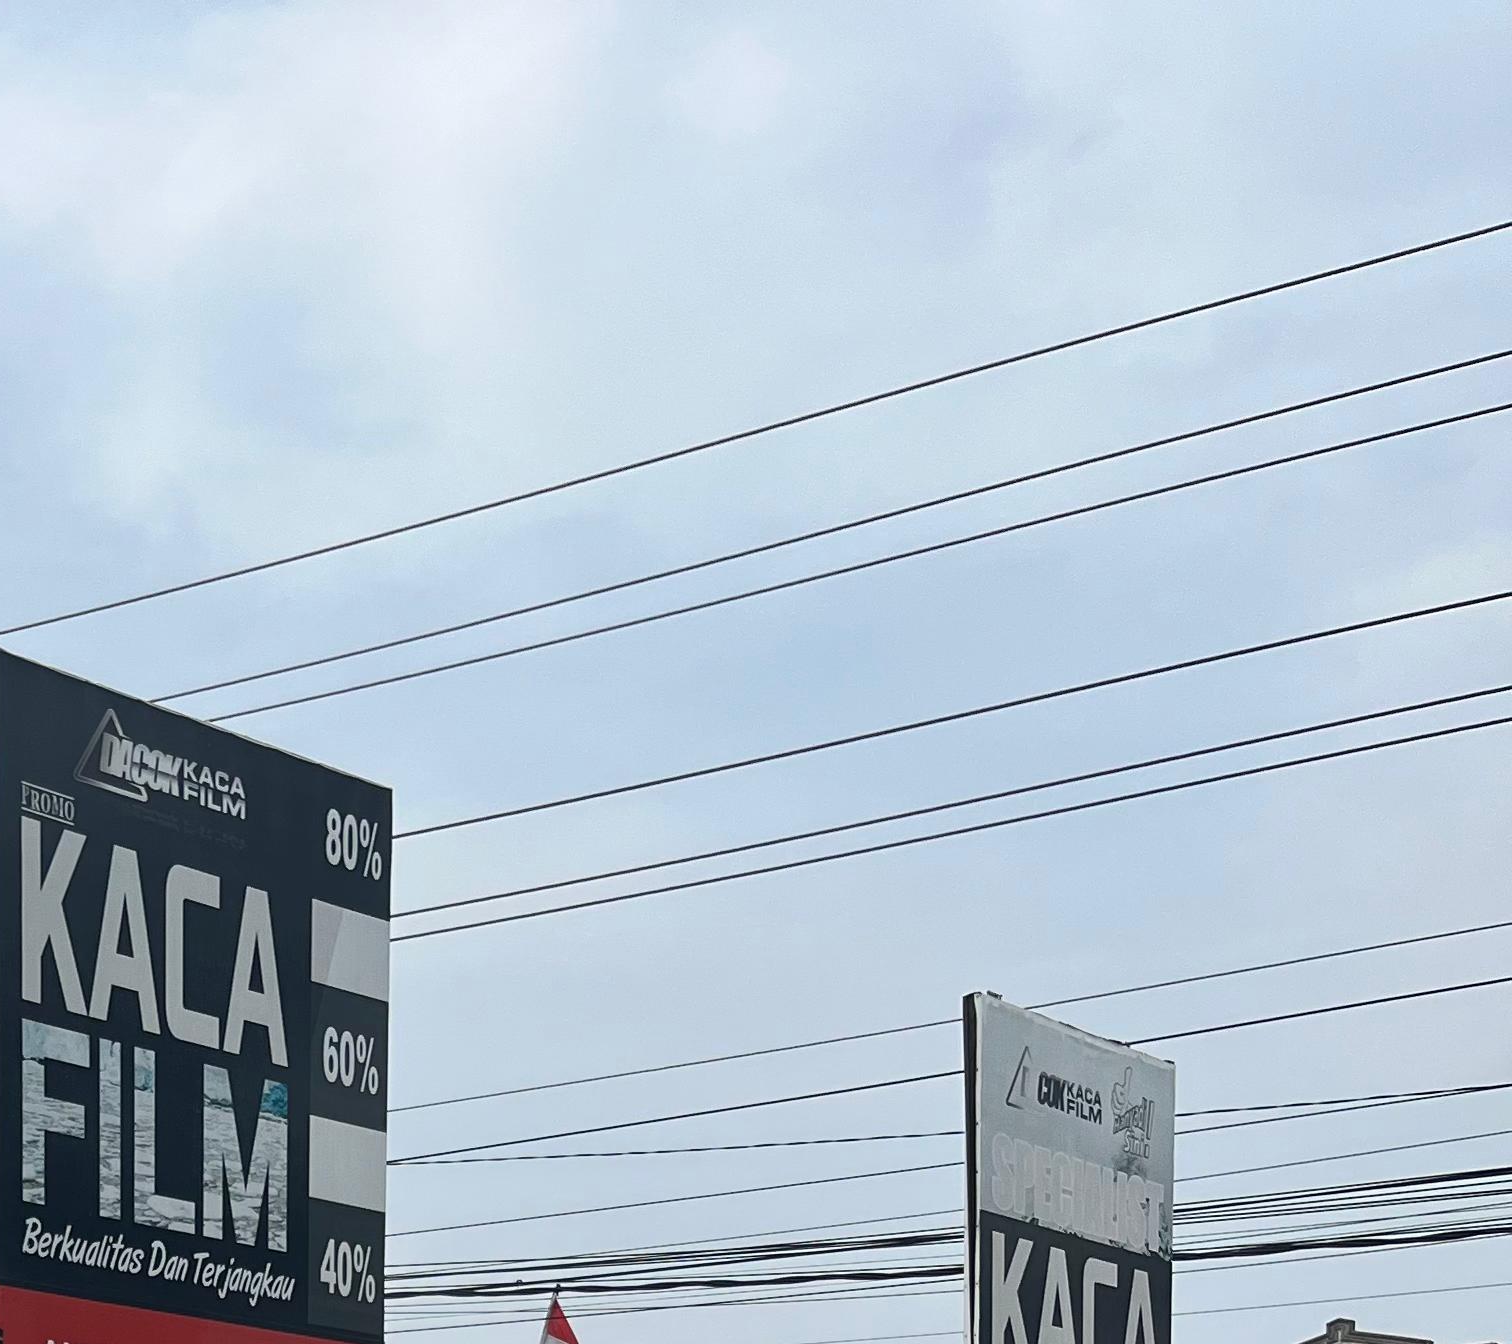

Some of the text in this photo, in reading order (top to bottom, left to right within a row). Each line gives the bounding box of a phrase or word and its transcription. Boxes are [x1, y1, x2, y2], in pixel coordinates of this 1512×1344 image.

[21, 784, 75, 820] PROMO
[183, 758, 246, 799] KACA
[183, 782, 247, 820] FILM
[325, 808, 382, 881] 80%
[21, 816, 289, 1067] KACA
[323, 1026, 379, 1095] 60%
[1066, 1099, 1102, 1125] FILM
[1067, 1081, 1102, 1108] KACA
[22, 1018, 288, 1252] FILM
[22, 1217, 296, 1306] Berkualitas Dan Terjangkau
[320, 1239, 376, 1303] 40%
